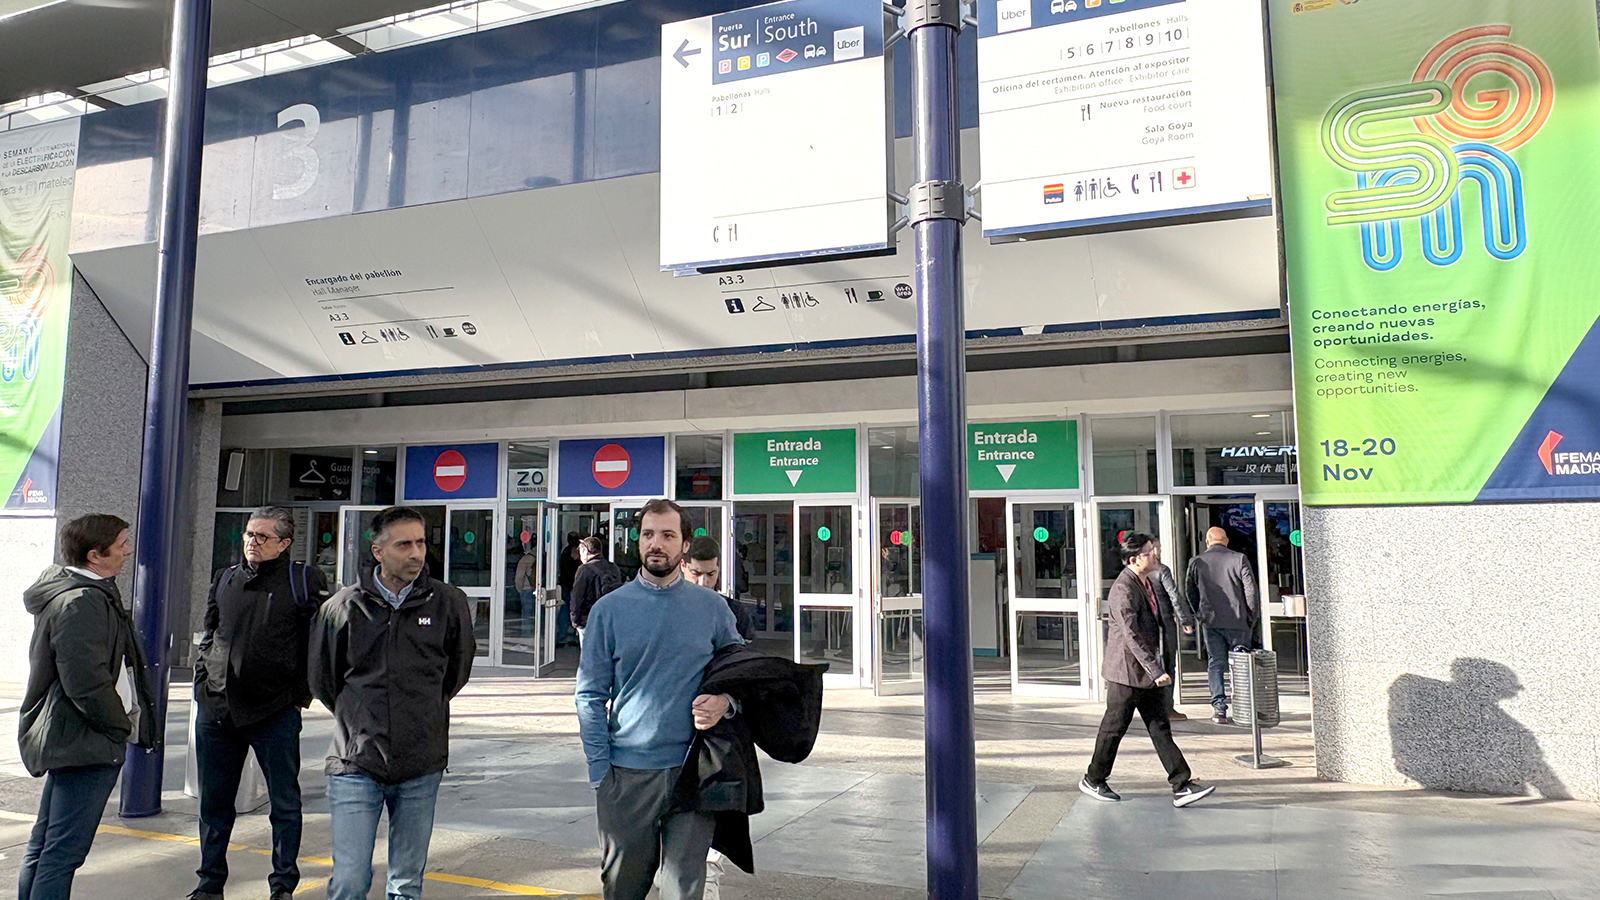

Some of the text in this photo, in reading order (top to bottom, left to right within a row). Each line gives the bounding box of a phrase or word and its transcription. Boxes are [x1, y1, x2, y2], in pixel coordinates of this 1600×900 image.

[1001, 8, 1027, 21] Uber
[718, 12, 795, 33] Puerta Entrance
[1109, 19, 1161, 34] Pabellones
[718, 18, 818, 52] Sur South
[1165, 28, 1183, 42] 10
[837, 38, 861, 51] Uber
[992, 82, 1023, 94] Oficina
[1025, 78, 1039, 88] del
[1088, 65, 1131, 79] Atención
[1144, 55, 1191, 71] expositor
[1054, 81, 1097, 95] Exhibition
[1129, 70, 1168, 83] Exhibitor
[1171, 66, 1190, 76] care
[712, 90, 751, 103] Pabellones
[1100, 88, 1192, 110] Nueva restauración
[1143, 100, 1192, 115] Food court
[1144, 120, 1193, 135] Sala Goya
[1141, 130, 1194, 146] Goya Room
[3, 147, 33, 159] SEMANA
[272, 103, 320, 199] 3
[305, 269, 402, 286] Encargado del pabellón
[718, 275, 745, 286] A3.3
[328, 285, 361, 296] Manager
[329, 312, 350, 322] A3.3
[1312, 299, 1487, 321] Conectando energías,
[1312, 316, 1435, 334] creando nuevas
[1313, 331, 1434, 349] oportunidades.
[1315, 355, 1398, 370] Connecting
[1315, 369, 1408, 384] creating new
[1316, 383, 1419, 399] opportunities.
[766, 437, 822, 452] Entrada
[973, 429, 1038, 446] Entrada
[977, 448, 1035, 462] Entrance
[1320, 438, 1397, 458] 18-20
[769, 454, 819, 467] Entrance
[1554, 451, 1600, 464] IFEMA
[1323, 464, 1374, 482] Nov
